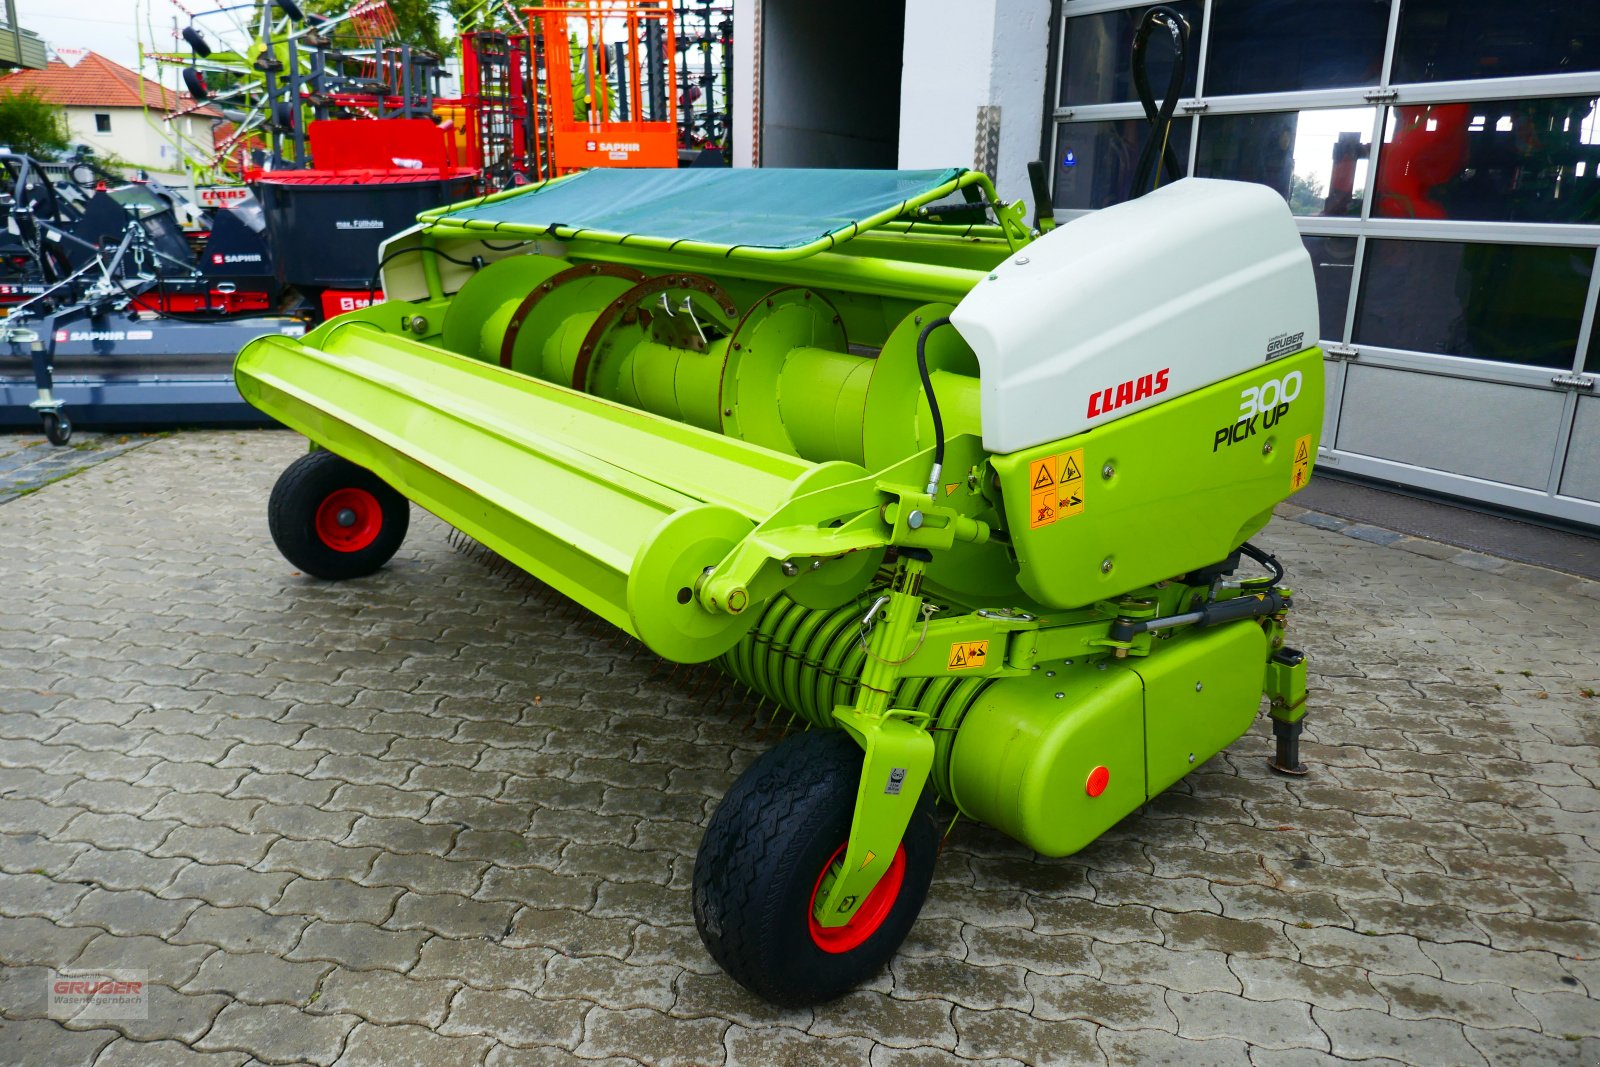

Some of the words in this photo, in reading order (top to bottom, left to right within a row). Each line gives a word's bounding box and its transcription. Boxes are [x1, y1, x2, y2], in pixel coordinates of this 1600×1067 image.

[599, 142, 640, 152] SAPHIR
[224, 254, 262, 263] SAPHIR
[11, 286, 45, 294] SPHIR
[70, 330, 125, 341] SAPHIR
[1267, 331, 1305, 352] GRUBER
[1086, 367, 1170, 419] CLAAS
[1237, 370, 1303, 422] 300
[1212, 414, 1260, 453] PICK
[1262, 401, 1290, 430] UP
